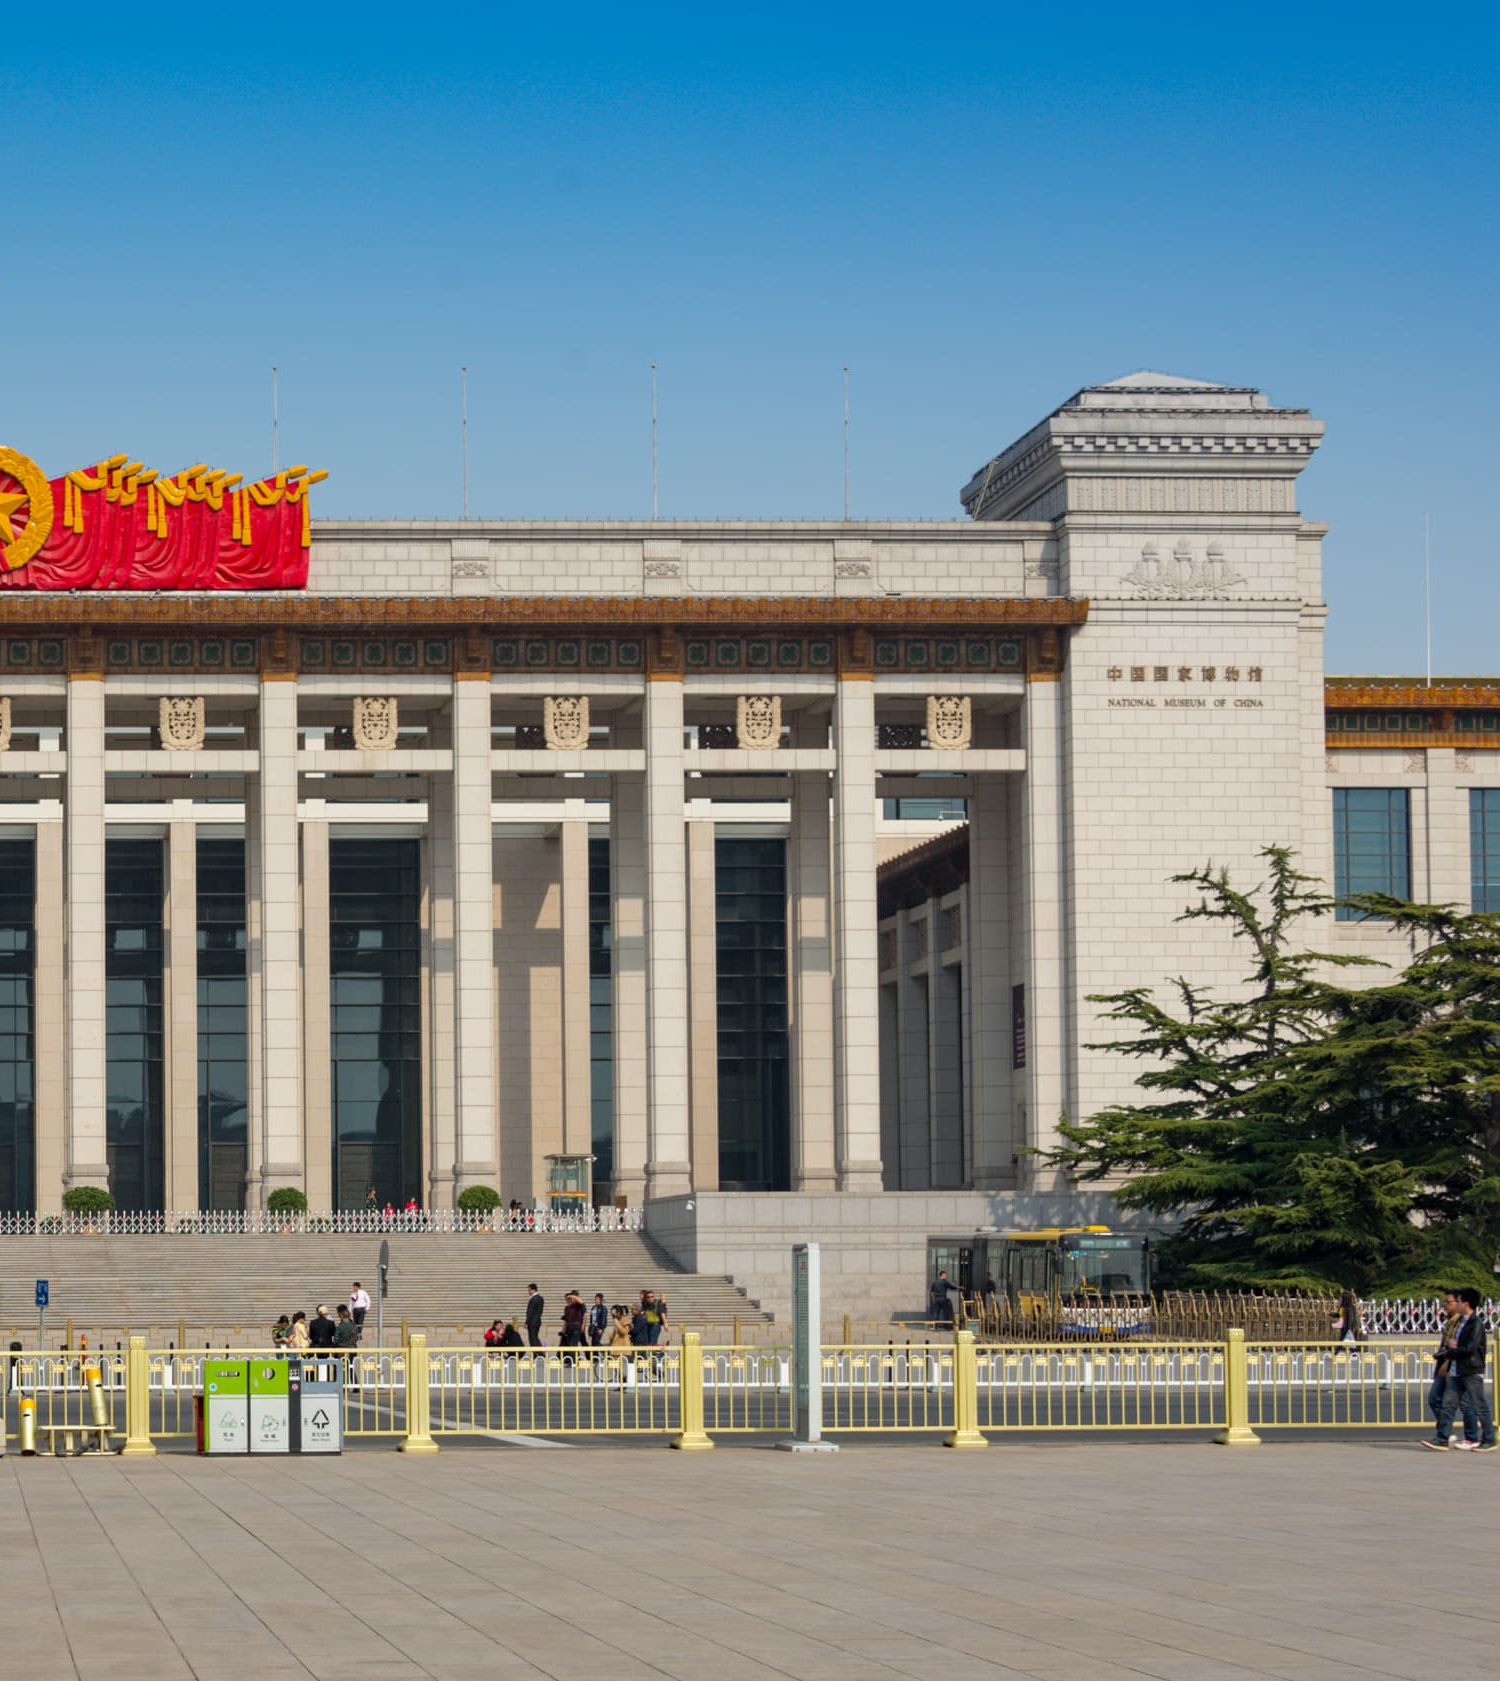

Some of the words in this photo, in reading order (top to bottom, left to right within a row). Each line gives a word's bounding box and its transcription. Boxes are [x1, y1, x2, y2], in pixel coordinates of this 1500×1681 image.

[1107, 665, 1263, 683] 中国国家博物馆
[1108, 698, 1157, 708] NATIONAL
[1164, 698, 1207, 708] MUSEUM
[1213, 698, 1226, 708] OF
[1234, 698, 1264, 708] CHINA
